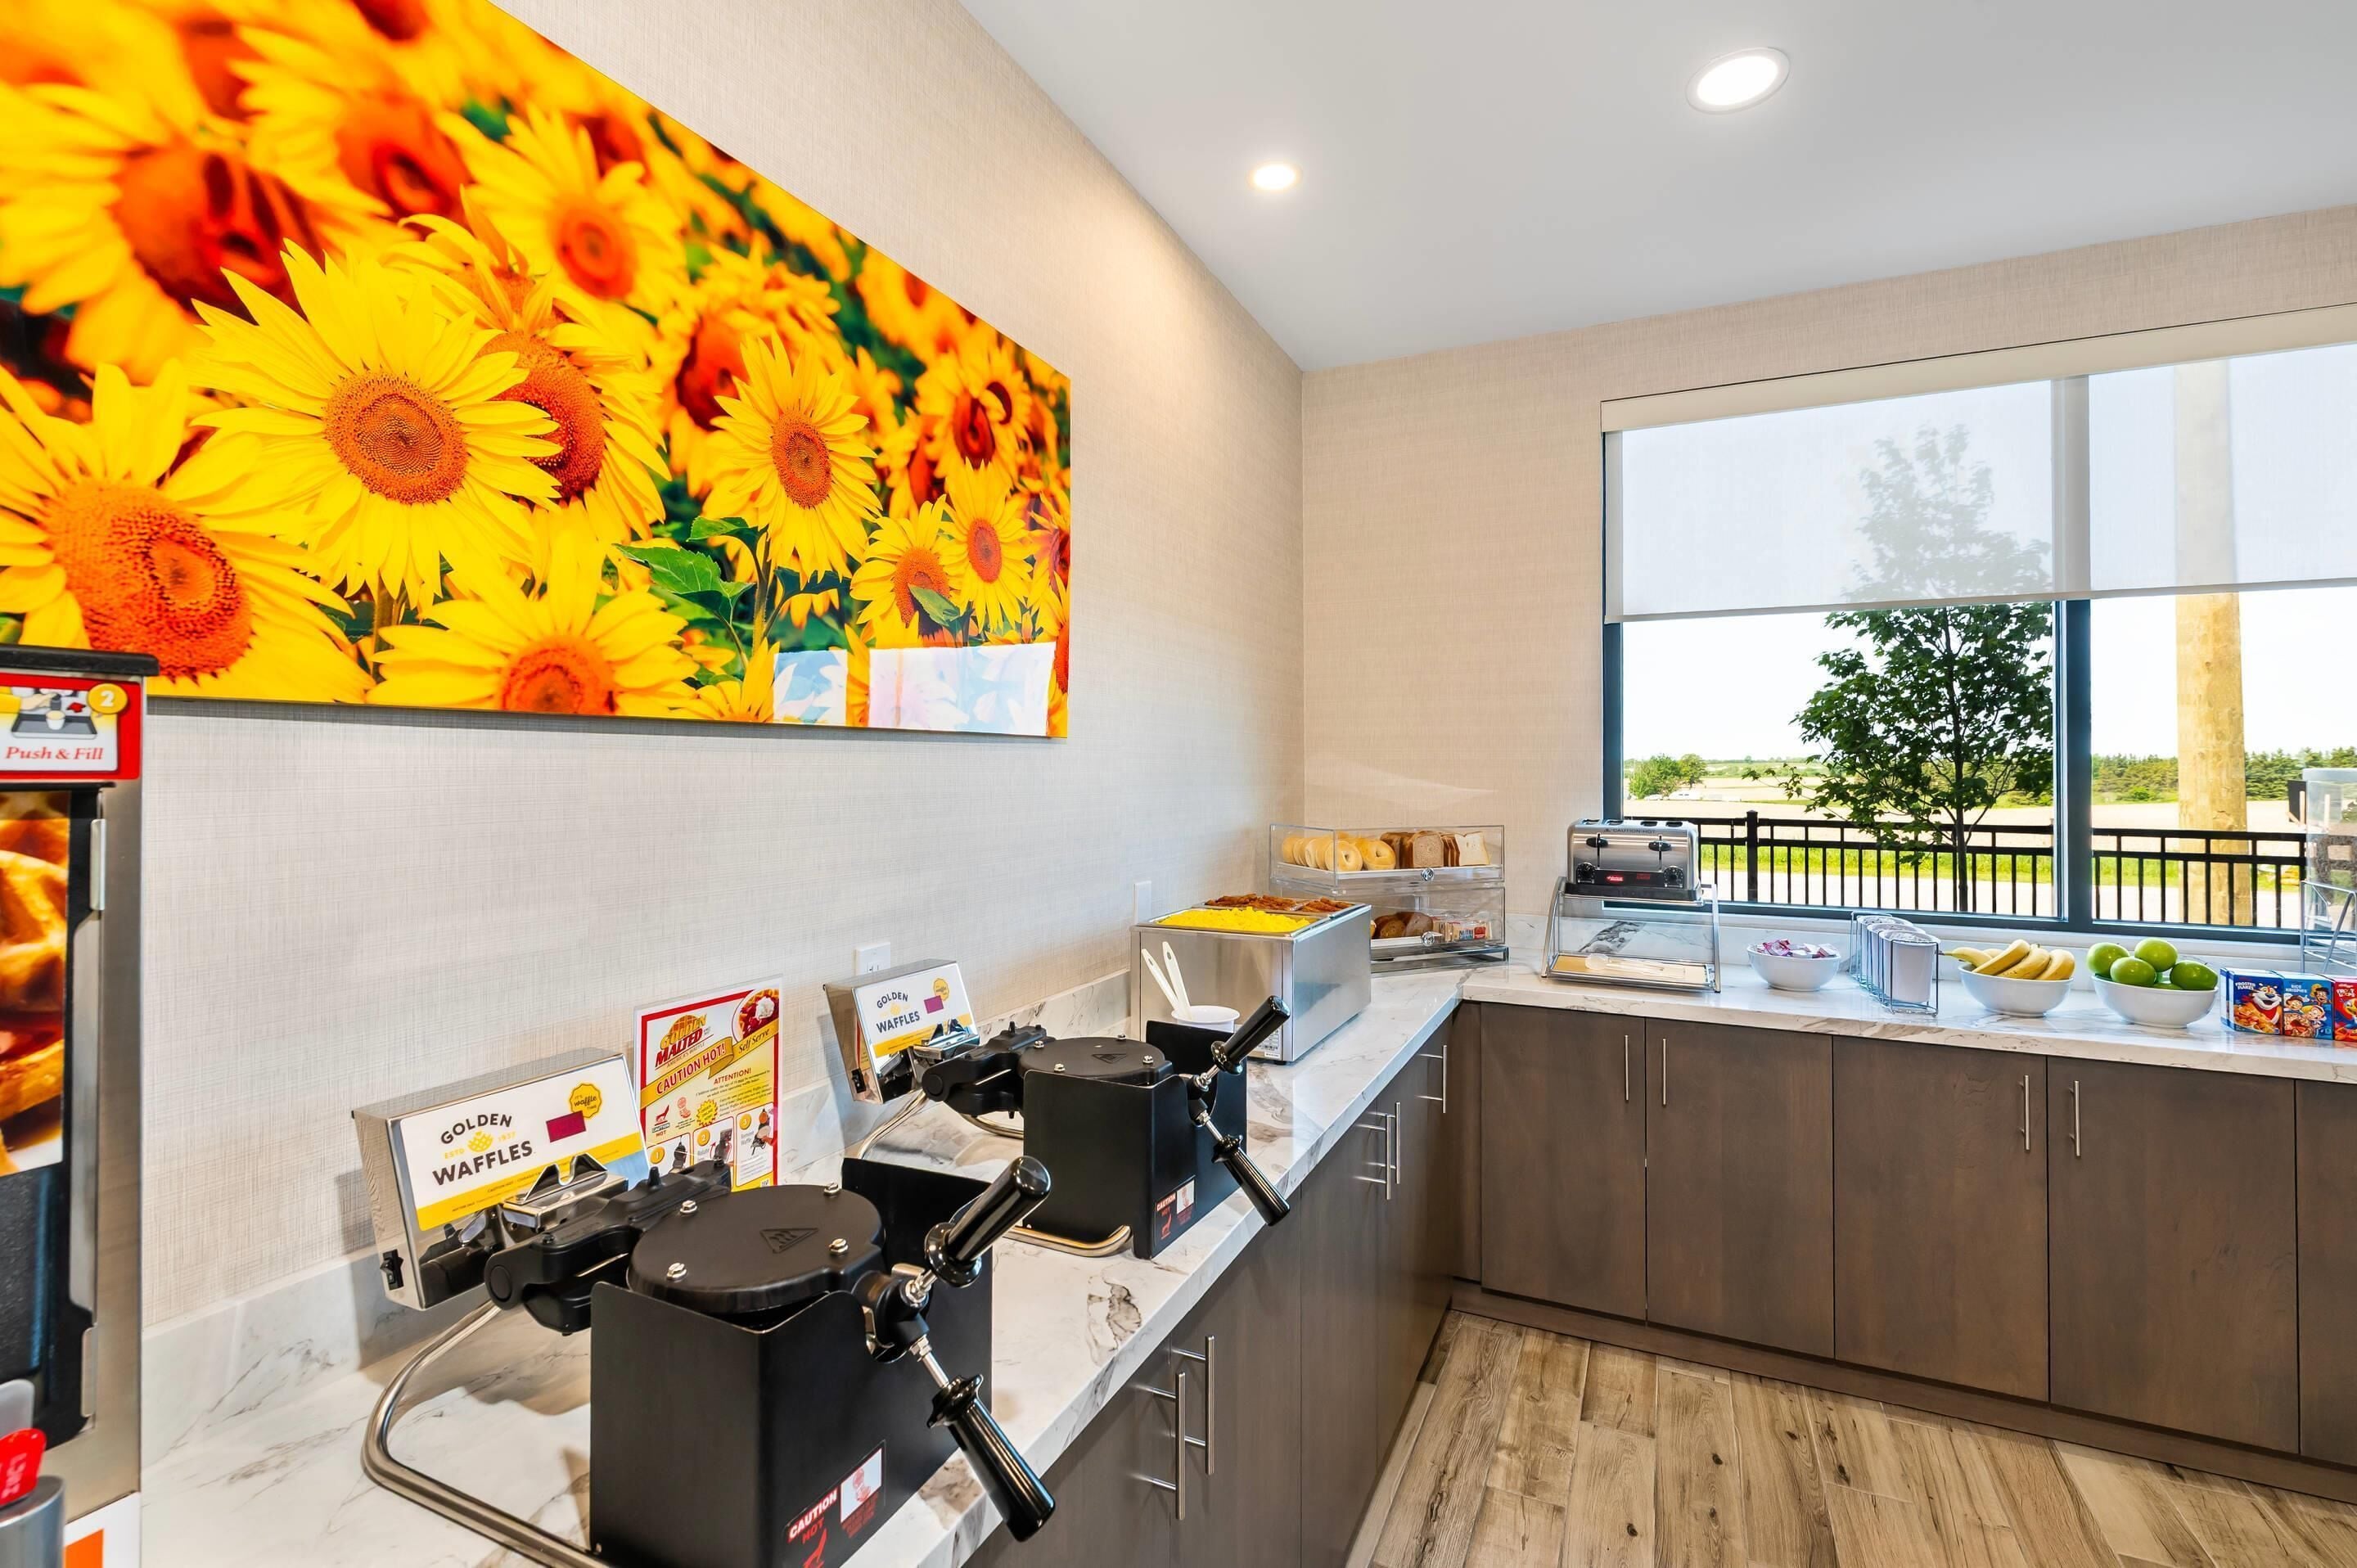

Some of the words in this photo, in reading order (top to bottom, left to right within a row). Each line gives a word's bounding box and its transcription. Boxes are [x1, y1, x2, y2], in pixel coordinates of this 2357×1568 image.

[100, 690, 115, 707] 2
[5, 746, 52, 760] Push
[55, 747, 69, 760] &
[73, 747, 104, 760] Fill
[877, 992, 908, 1008] GOLDEN
[876, 1011, 920, 1034] WAFFLES
[655, 1028, 703, 1067] MALTED
[738, 1039, 752, 1054] Self
[752, 1029, 770, 1044] Serve
[656, 1057, 701, 1094] CAUTION
[702, 1043, 725, 1066] HOT!
[714, 1067, 751, 1085] ATTENTION!
[574, 1095, 597, 1106] waffle
[440, 1113, 512, 1144] GOLDEN
[432, 1140, 533, 1186] WAFFLES
[1156, 1192, 1176, 1211] CAUTION
[789, 1488, 838, 1540] CAUTION
[802, 1516, 824, 1544] HOT
